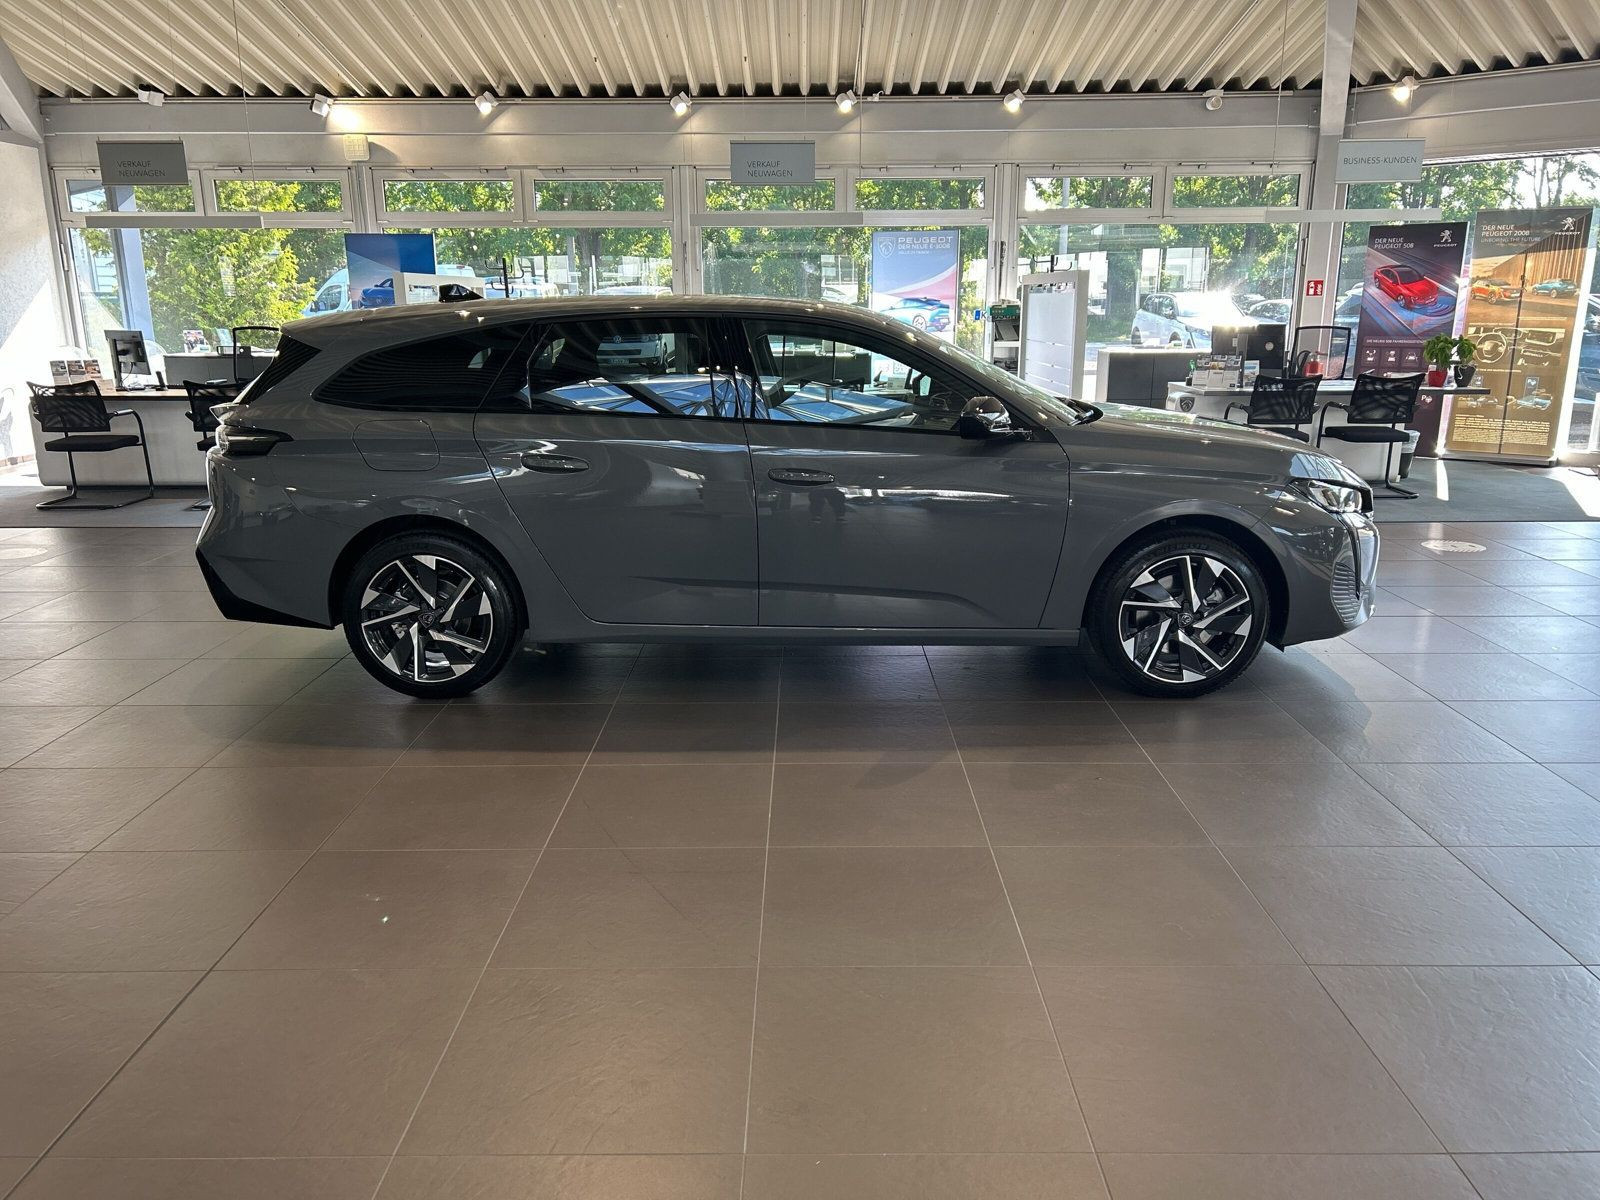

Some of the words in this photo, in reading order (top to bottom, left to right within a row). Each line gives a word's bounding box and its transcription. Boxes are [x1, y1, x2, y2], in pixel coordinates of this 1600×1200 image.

[116, 160, 152, 168] VERKAUF
[746, 160, 781, 168] VERKAUF
[1343, 156, 1418, 165] BUSINESS-KUNDEN
[118, 169, 166, 177] NEUWAGEN
[747, 169, 793, 177] NEUWAGEN
[898, 236, 953, 244] PEUGEOT
